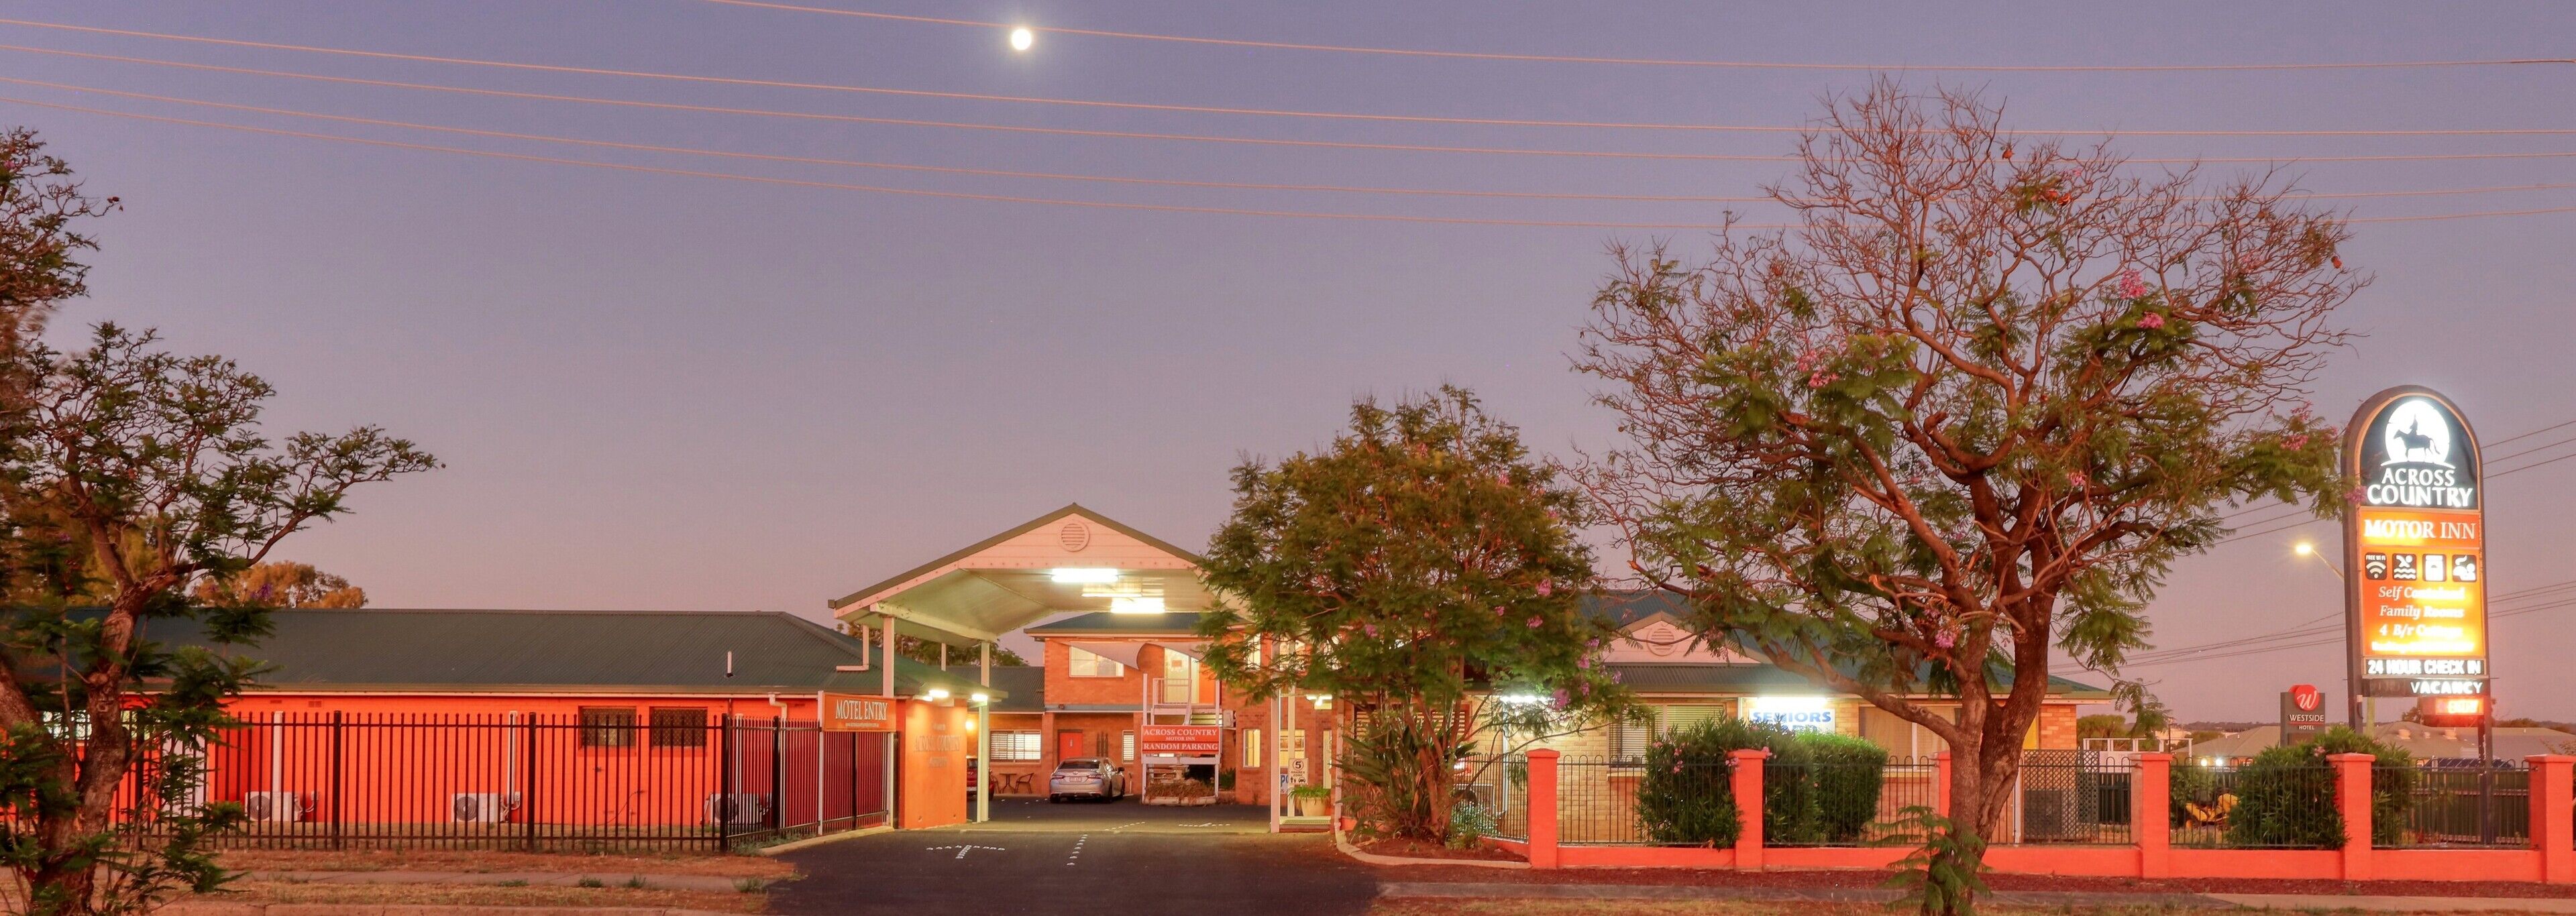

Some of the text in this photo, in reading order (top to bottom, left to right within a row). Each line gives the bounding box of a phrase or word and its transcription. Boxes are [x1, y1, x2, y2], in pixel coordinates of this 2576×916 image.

[2381, 467, 2455, 486] ACROSS
[2367, 484, 2473, 507] COUNTRY
[2363, 519, 2477, 540] MOTOR INN
[2378, 586, 2403, 601] Self
[2379, 605, 2421, 620] Family
[2379, 624, 2388, 636] 4
[2367, 659, 2481, 675] 24 HOUR CHECK IN
[2410, 681, 2483, 694] VACANCY
[2296, 690, 2317, 709] W
[835, 699, 888, 720] MOTEL ENTRY
[1295, 761, 1302, 769] 5
